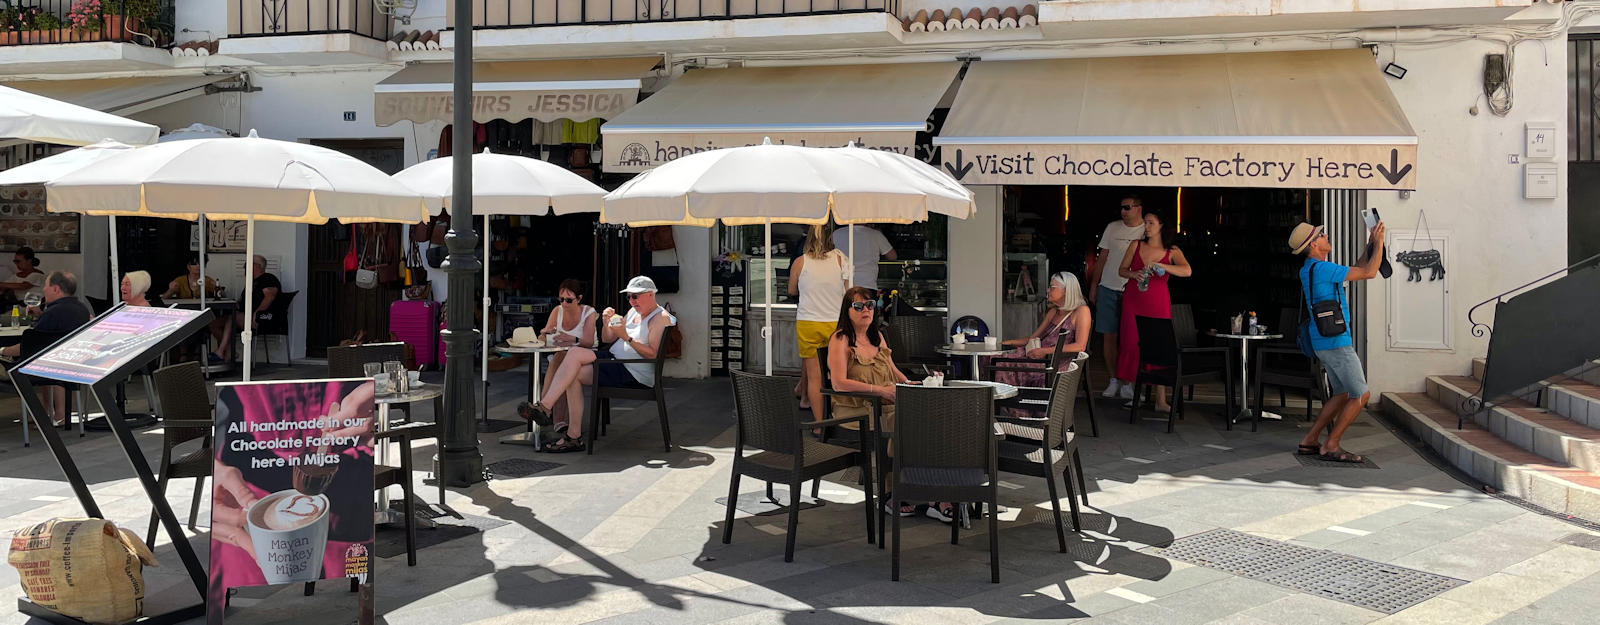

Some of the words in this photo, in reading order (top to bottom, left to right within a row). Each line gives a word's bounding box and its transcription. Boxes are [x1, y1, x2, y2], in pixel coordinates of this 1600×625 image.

[528, 93, 626, 114] JESSICA
[976, 151, 1035, 175] Visit
[1044, 153, 1174, 177] Chocolate
[1184, 152, 1295, 183] Factory
[1306, 157, 1374, 179] Here
[227, 422, 247, 434] All
[250, 418, 325, 433] handmade
[328, 416, 340, 428] in
[343, 417, 367, 428] our
[230, 436, 303, 452] Chocolate
[305, 434, 360, 448] Factory
[251, 456, 285, 469] here
[288, 455, 301, 467] in
[303, 453, 341, 467] Mijas
[271, 537, 310, 553] Mayan
[268, 547, 314, 563] Monkey
[276, 560, 308, 577] Mijas
[345, 566, 369, 575] mijas
